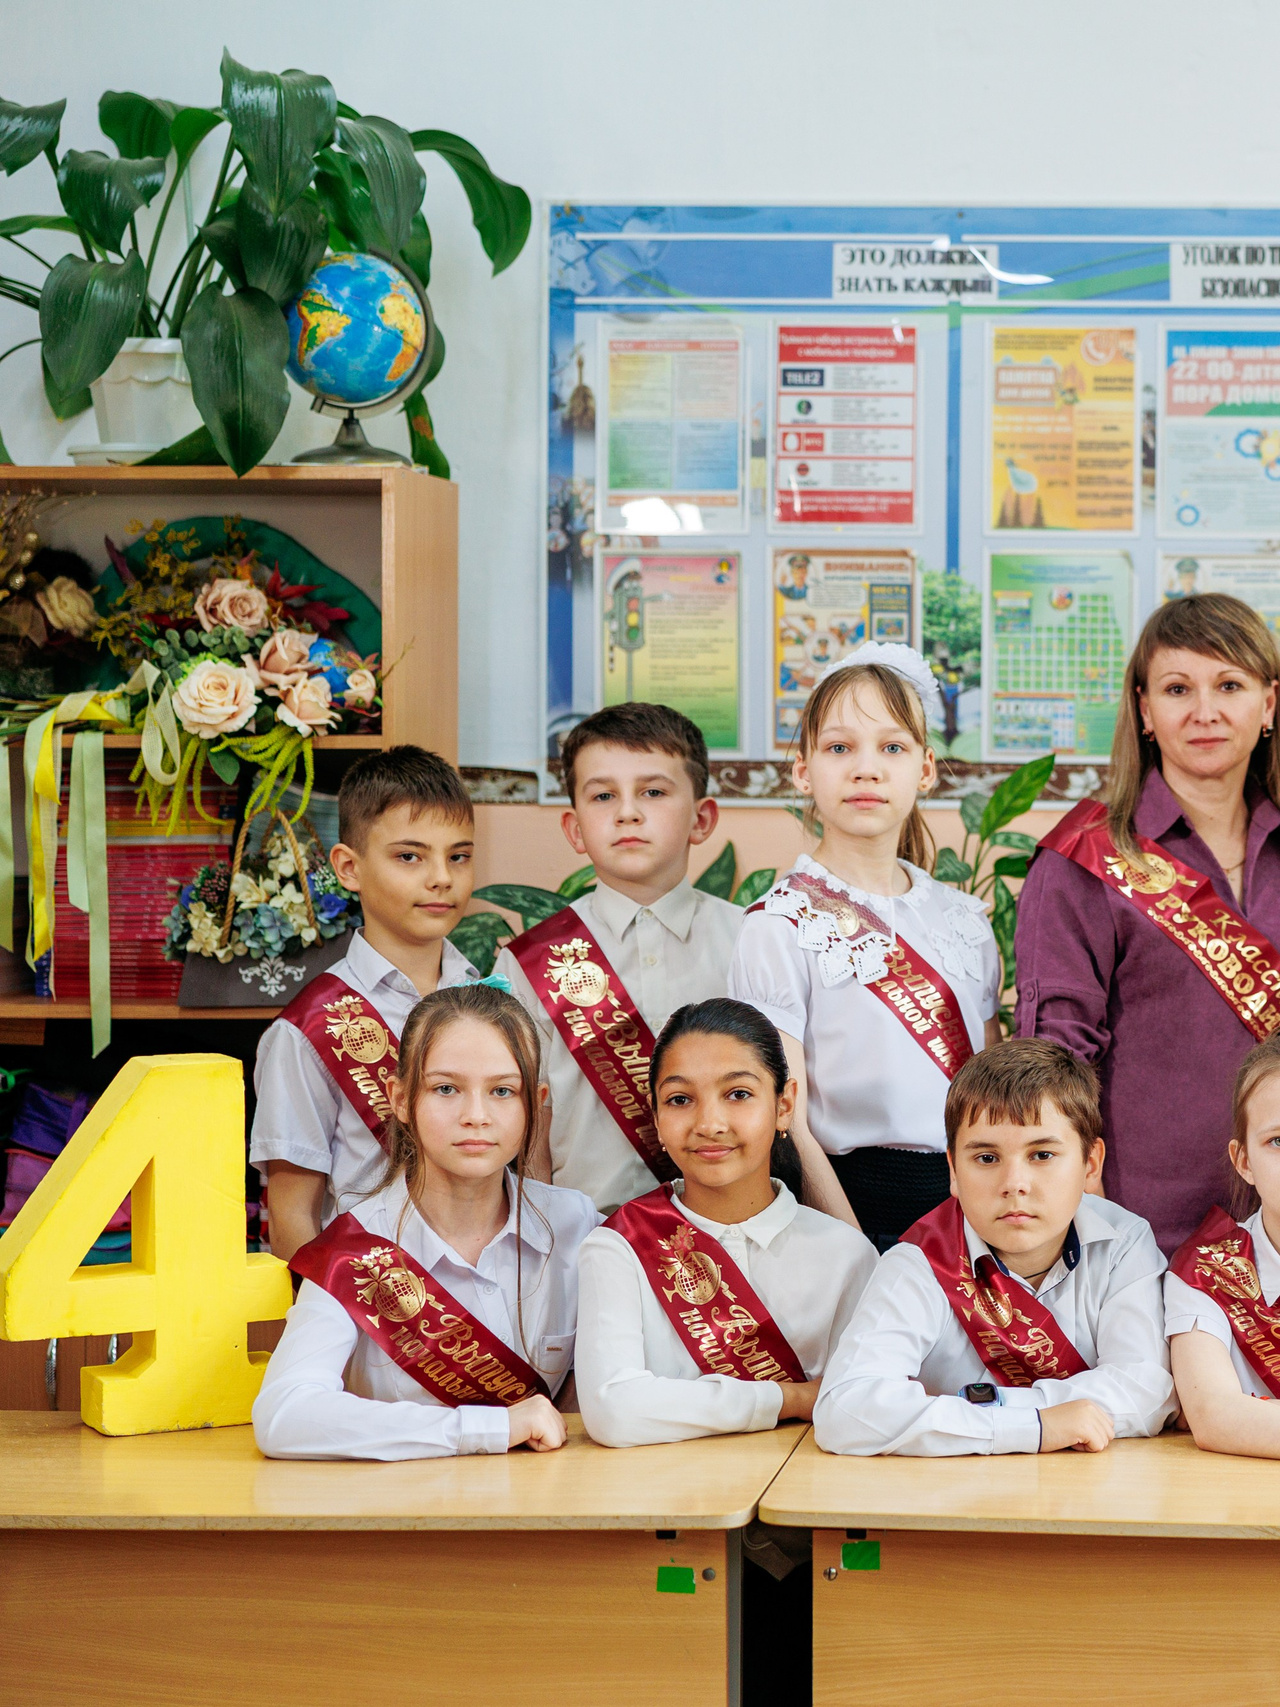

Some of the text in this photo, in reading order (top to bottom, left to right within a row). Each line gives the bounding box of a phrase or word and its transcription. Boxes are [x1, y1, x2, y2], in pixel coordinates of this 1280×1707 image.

[841, 248, 885, 266] ЭТО
[1183, 246, 1240, 266] УГОЛОК
[1245, 246, 1265, 266] ПО
[837, 275, 992, 297] ЗНАТЬ КАЖДЫЙ
[1172, 384, 1224, 404] ПОРА
[563, 1008, 648, 1120] начальной
[0, 1053, 293, 1437] 4
